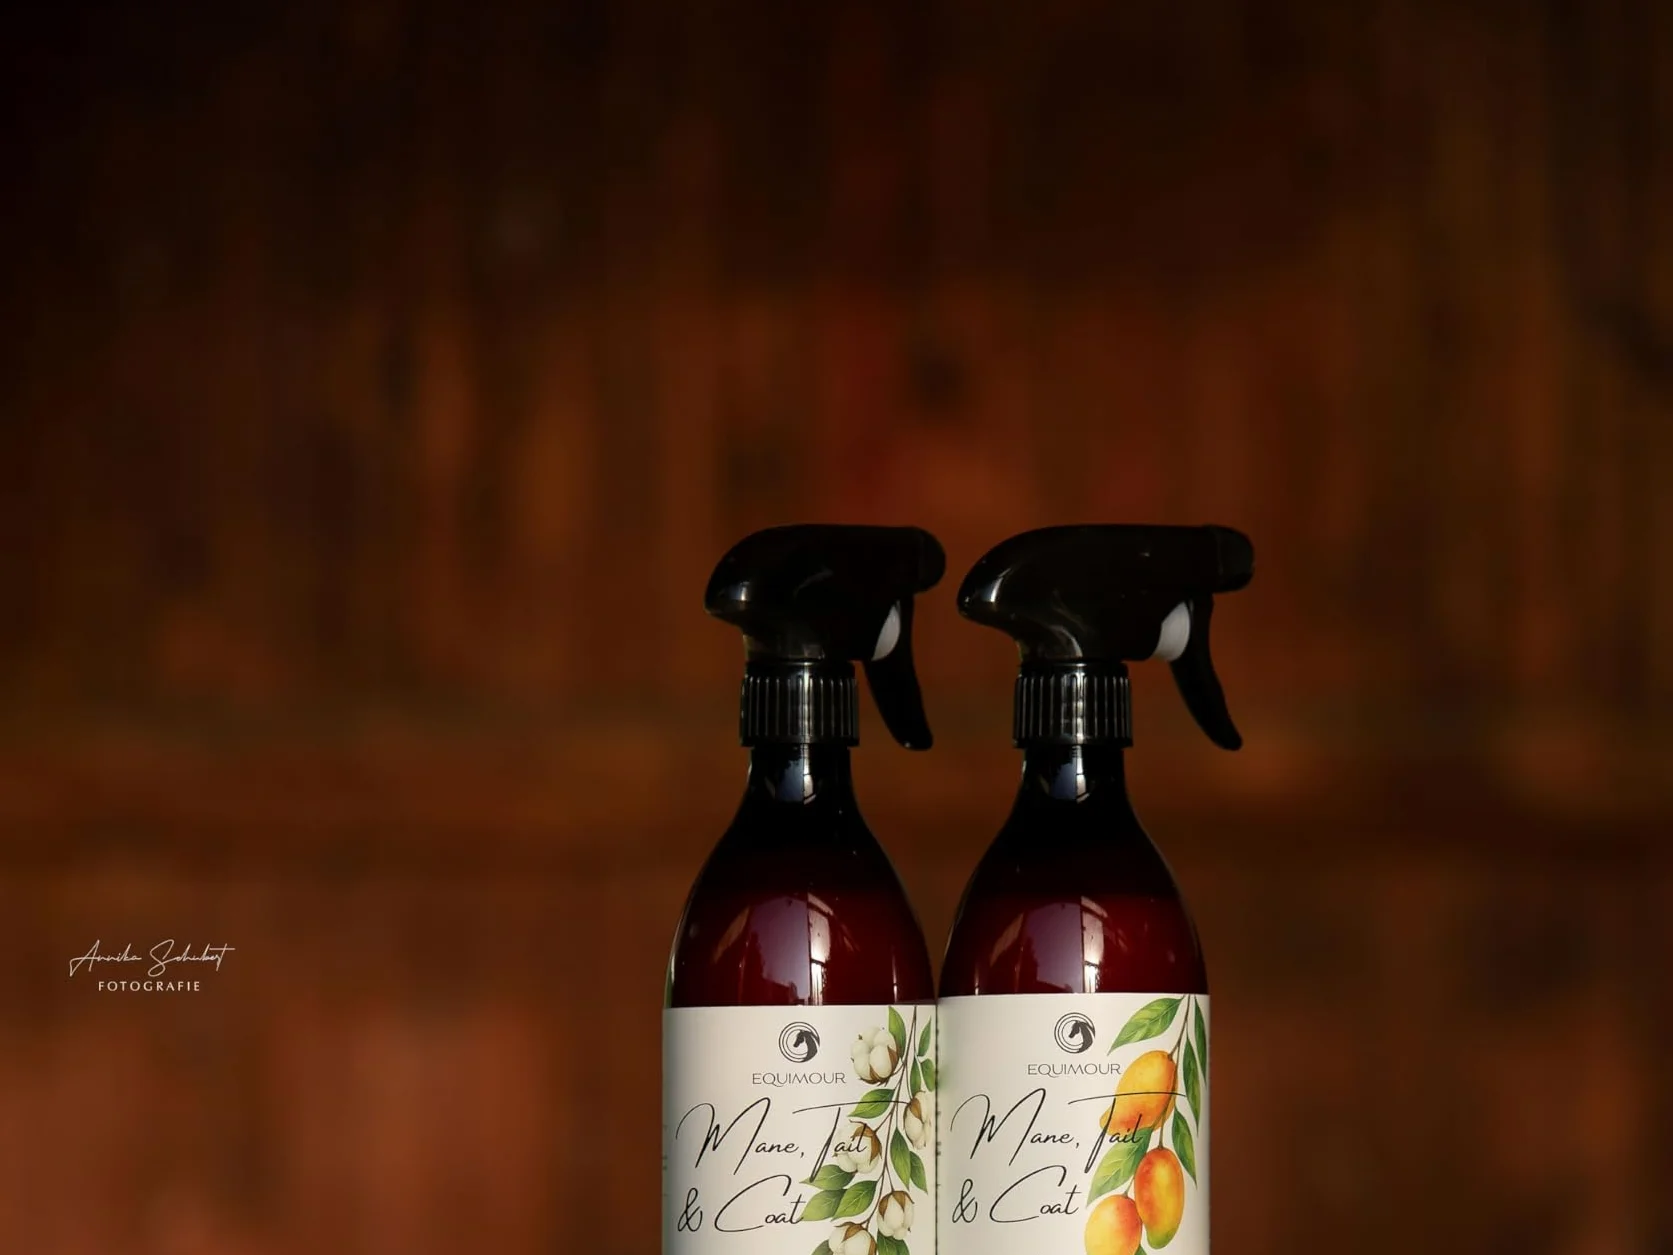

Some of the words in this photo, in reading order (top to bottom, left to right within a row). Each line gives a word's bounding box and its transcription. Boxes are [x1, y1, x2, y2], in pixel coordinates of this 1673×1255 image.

[751, 1072, 847, 1088] EQUIMOUR
[1027, 1063, 1122, 1078] EQUIMOUR
[674, 1096, 806, 1176] Mane,
[791, 1100, 909, 1183] Tail
[949, 1087, 1081, 1167] Mane,
[1067, 1091, 1186, 1174] Tail
[677, 1187, 704, 1233] &
[714, 1173, 807, 1233] Coat
[951, 1178, 979, 1224] &
[989, 1164, 1082, 1224] Coat
